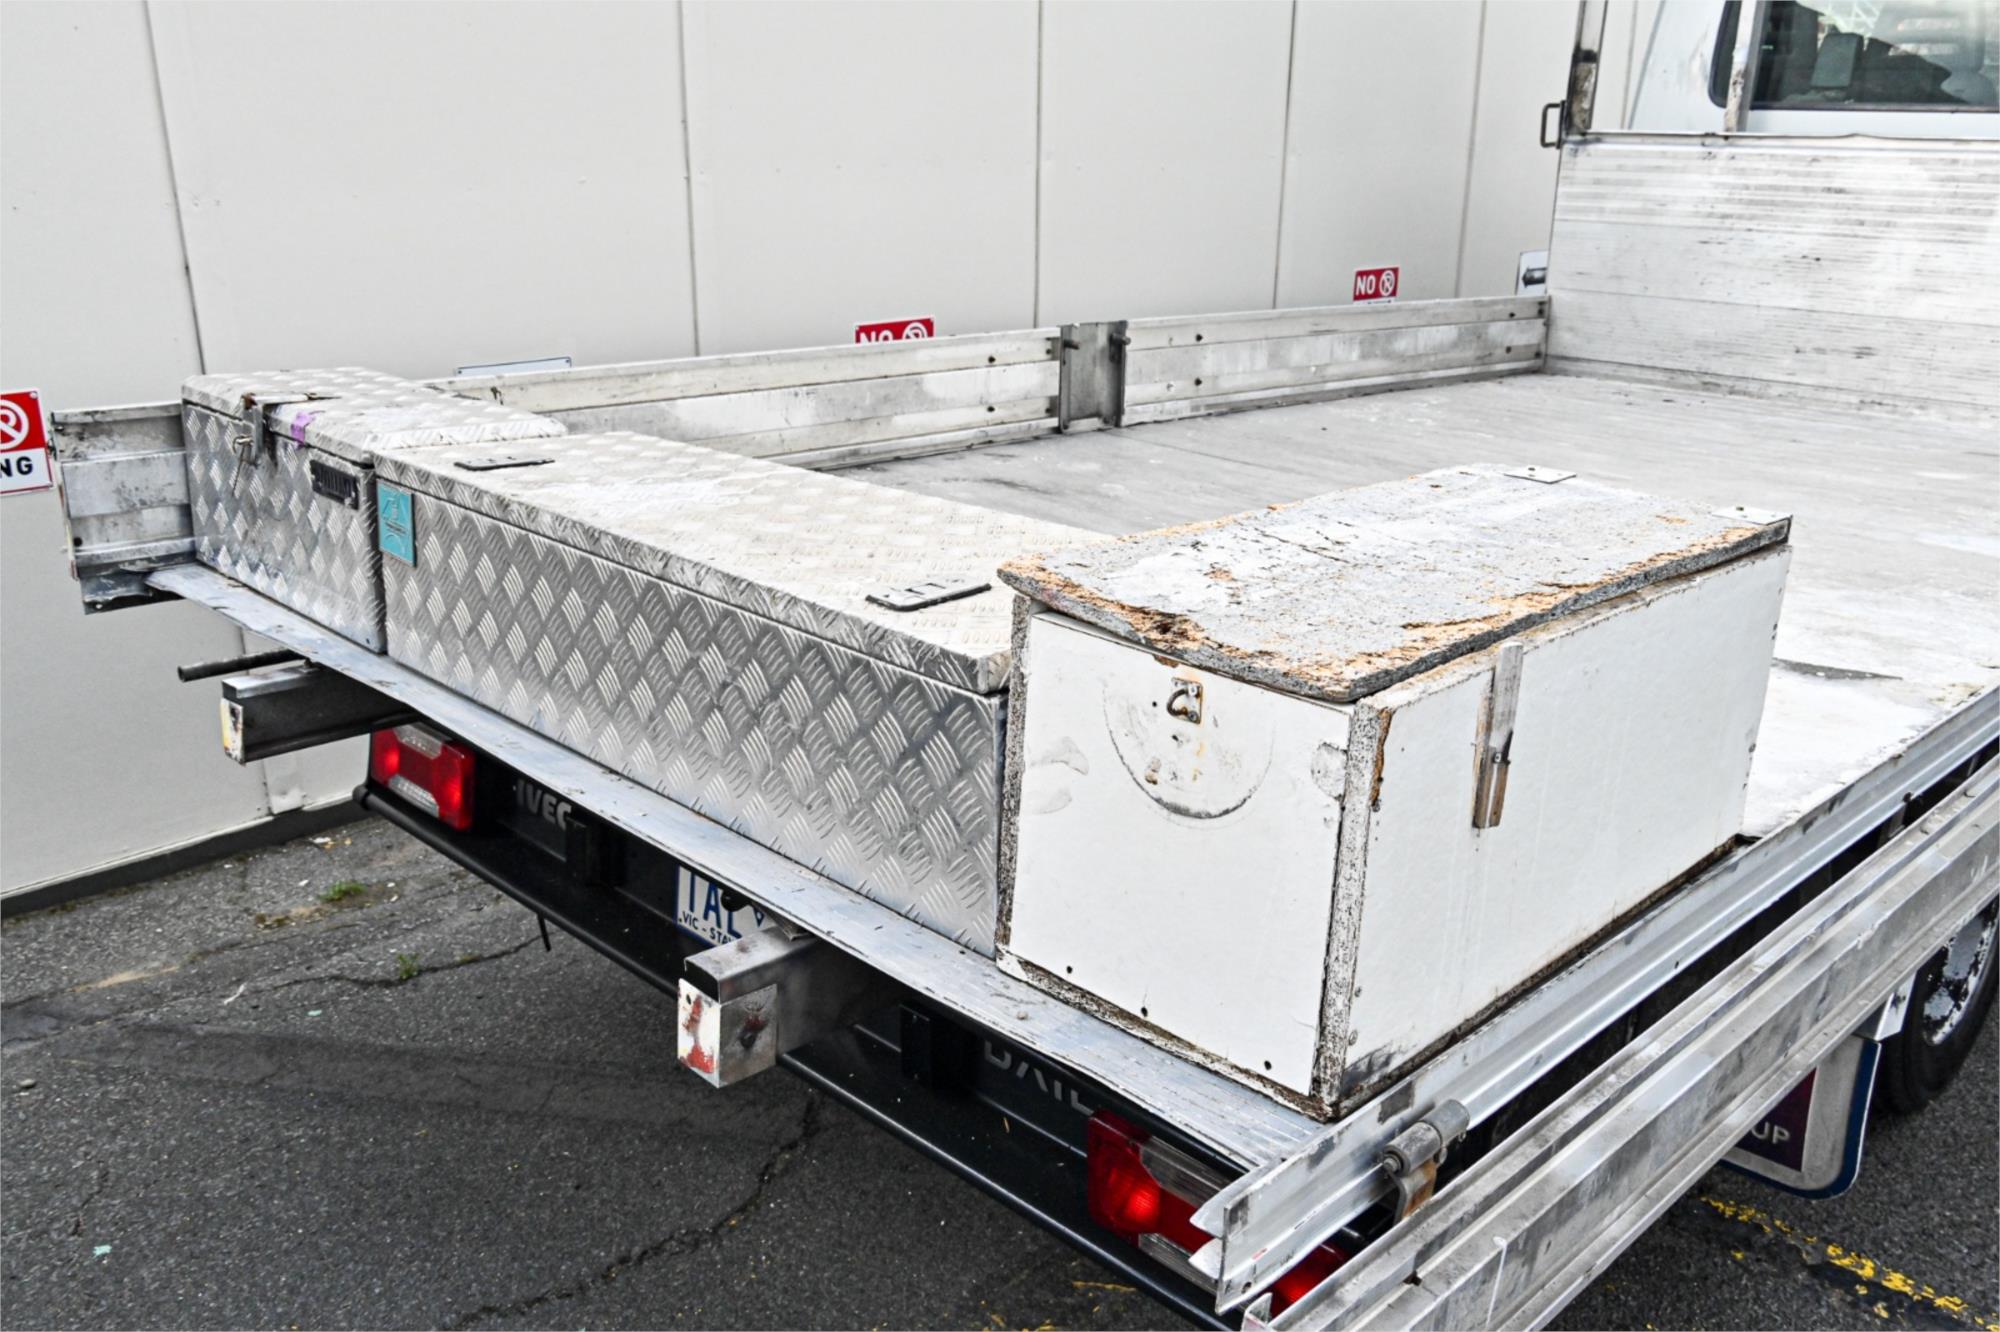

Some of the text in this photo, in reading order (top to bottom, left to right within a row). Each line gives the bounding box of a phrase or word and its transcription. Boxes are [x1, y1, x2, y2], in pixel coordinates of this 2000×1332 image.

[1355, 274, 1376, 296] NO
[682, 910, 700, 931] VIC
[709, 926, 733, 945] STA
